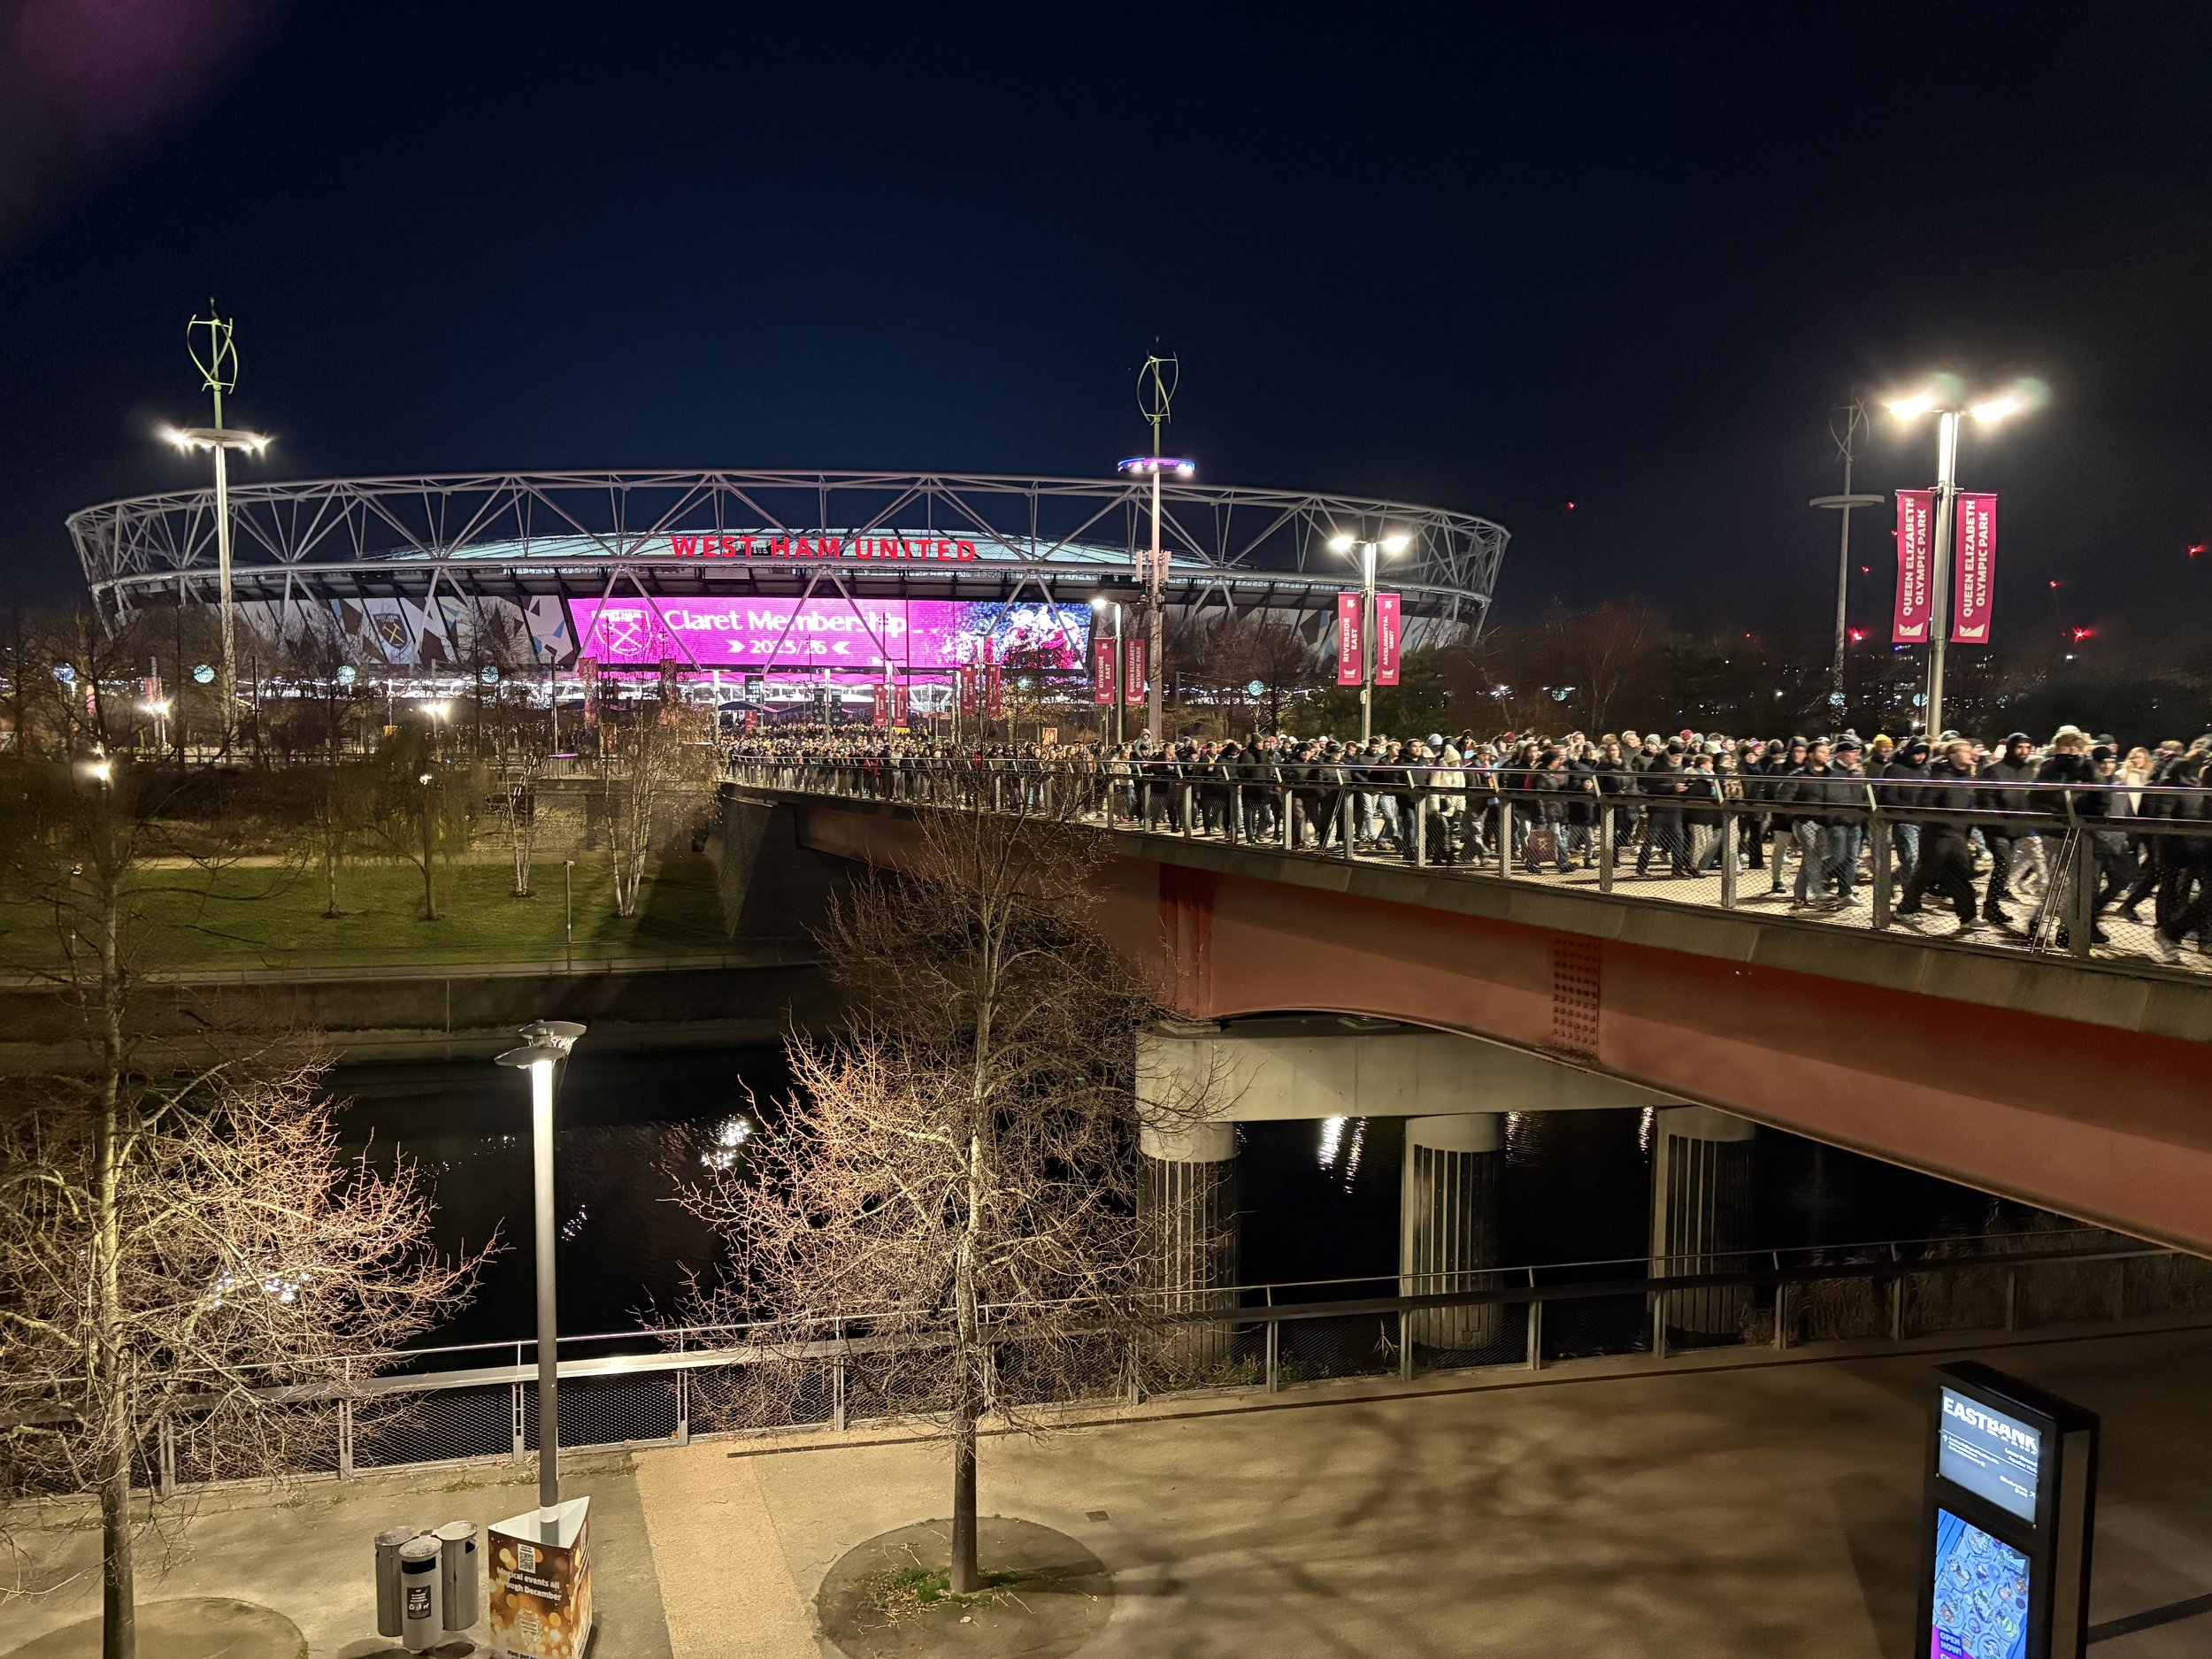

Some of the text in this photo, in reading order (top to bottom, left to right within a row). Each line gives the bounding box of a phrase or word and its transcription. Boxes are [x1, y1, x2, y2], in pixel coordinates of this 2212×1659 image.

[671, 535, 976, 562] WEST HAM UNITED
[1903, 497, 1915, 617] QUEEN ELIZABETH
[1916, 509, 1926, 606] OLYMPIC PARK
[1963, 500, 1976, 618] QUEEN ELIZABETH
[1976, 511, 1988, 607] OLYMPIC PARK
[664, 610, 743, 631] Claret
[748, 611, 908, 638] Membership
[524, 1575, 549, 1587] events
[549, 1581, 560, 1590] all
[524, 1586, 562, 1601] December
[1939, 1631, 1961, 1647] OPEN
[1940, 1640, 1962, 1656] NOW!
